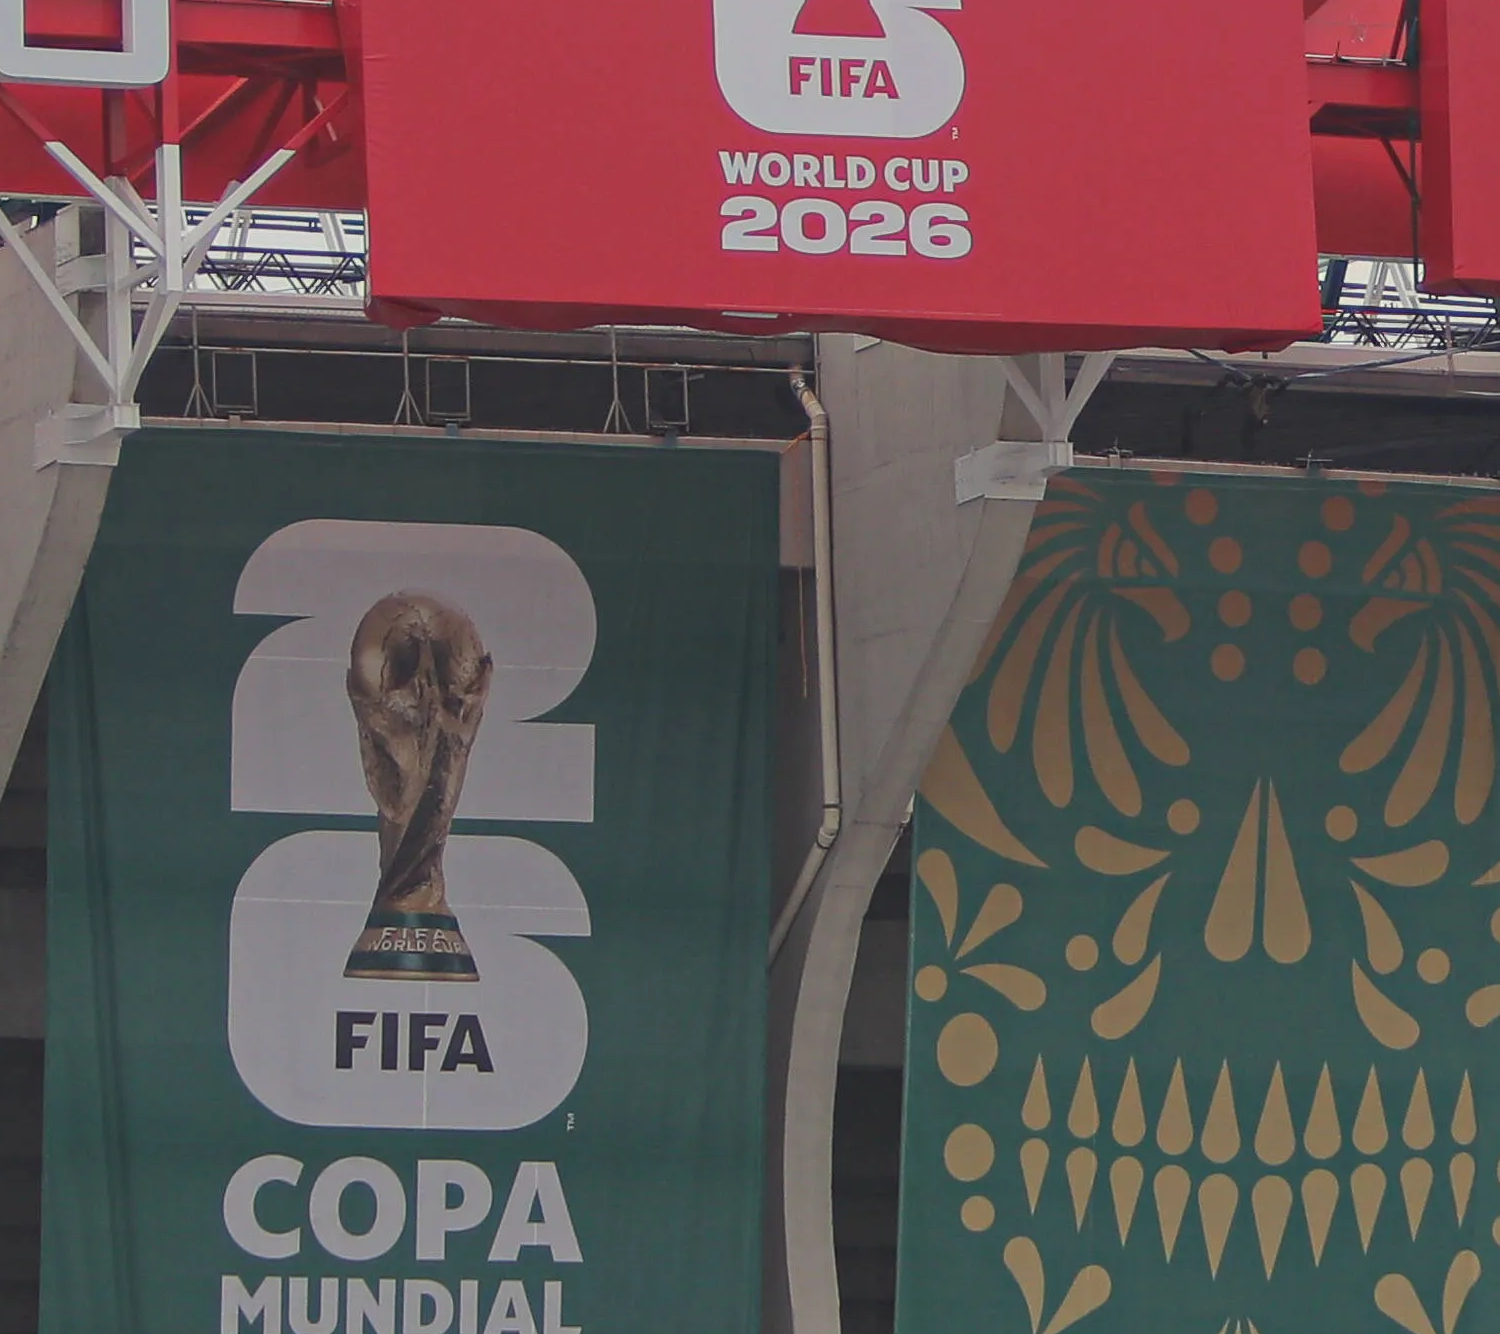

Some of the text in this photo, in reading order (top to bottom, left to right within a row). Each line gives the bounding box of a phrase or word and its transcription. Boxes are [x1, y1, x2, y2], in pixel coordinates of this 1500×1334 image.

[788, 56, 901, 100] FIFA
[718, 150, 970, 193] WORLD CUP
[720, 195, 973, 259] 2026
[381, 926, 446, 940] FIFA
[334, 1010, 495, 1074] FIFA
[222, 1154, 584, 1264] COPA
